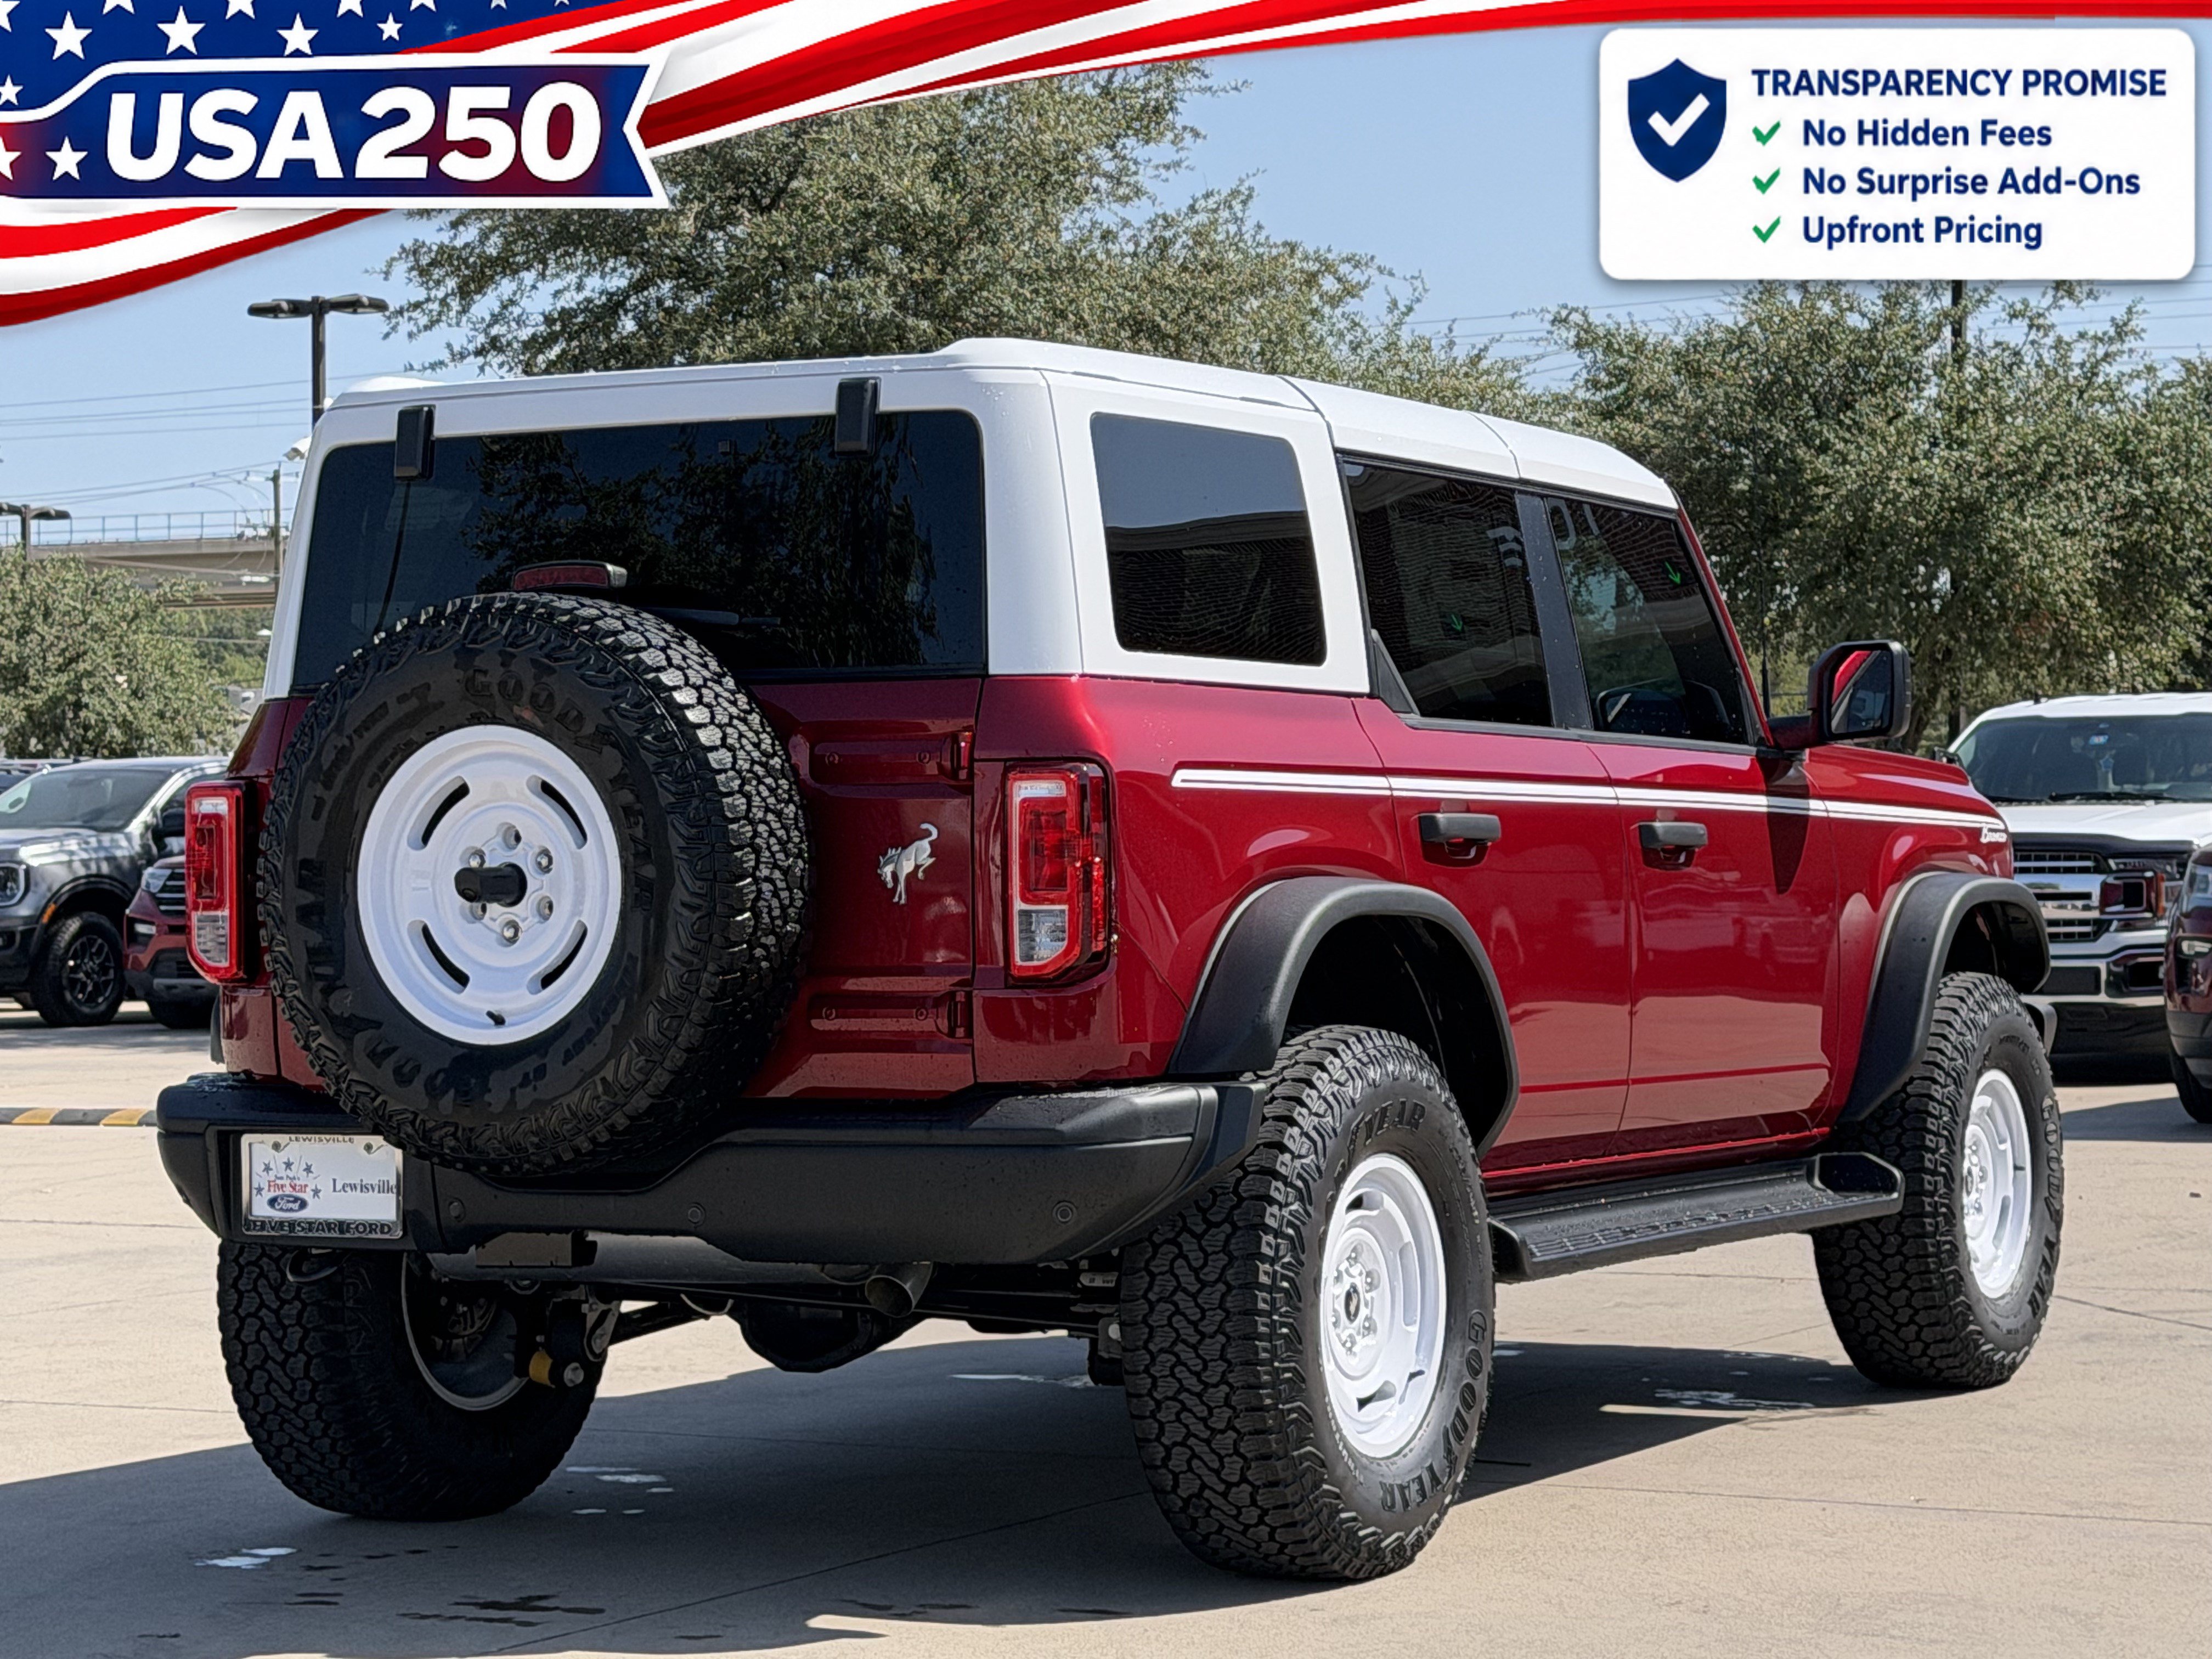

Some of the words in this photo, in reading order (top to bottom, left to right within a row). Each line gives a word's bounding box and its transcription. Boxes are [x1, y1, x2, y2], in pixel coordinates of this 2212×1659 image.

[288, 1136, 354, 1144] LEWISVILLE
[267, 1180, 287, 1193] Five
[289, 1180, 309, 1194] Star
[331, 1178, 397, 1195] Lewisville
[274, 1196, 301, 1210] Ford
[252, 1219, 292, 1233] FIVE
[296, 1220, 338, 1234] STAR
[345, 1221, 393, 1235] FORD
